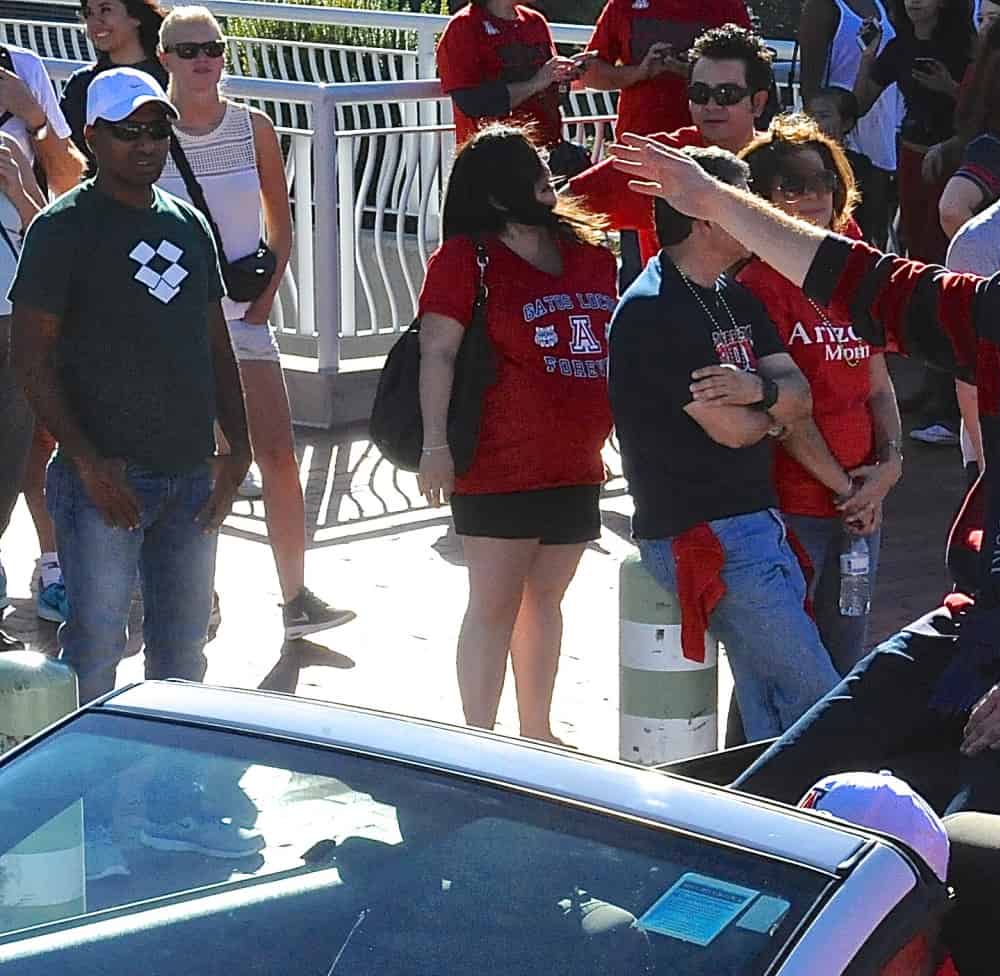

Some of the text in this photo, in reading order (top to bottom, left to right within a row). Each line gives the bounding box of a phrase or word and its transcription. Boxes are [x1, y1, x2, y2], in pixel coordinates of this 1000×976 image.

[568, 315, 602, 354] A
[788, 321, 863, 345] Arizo
[544, 356, 608, 378] FOREV
